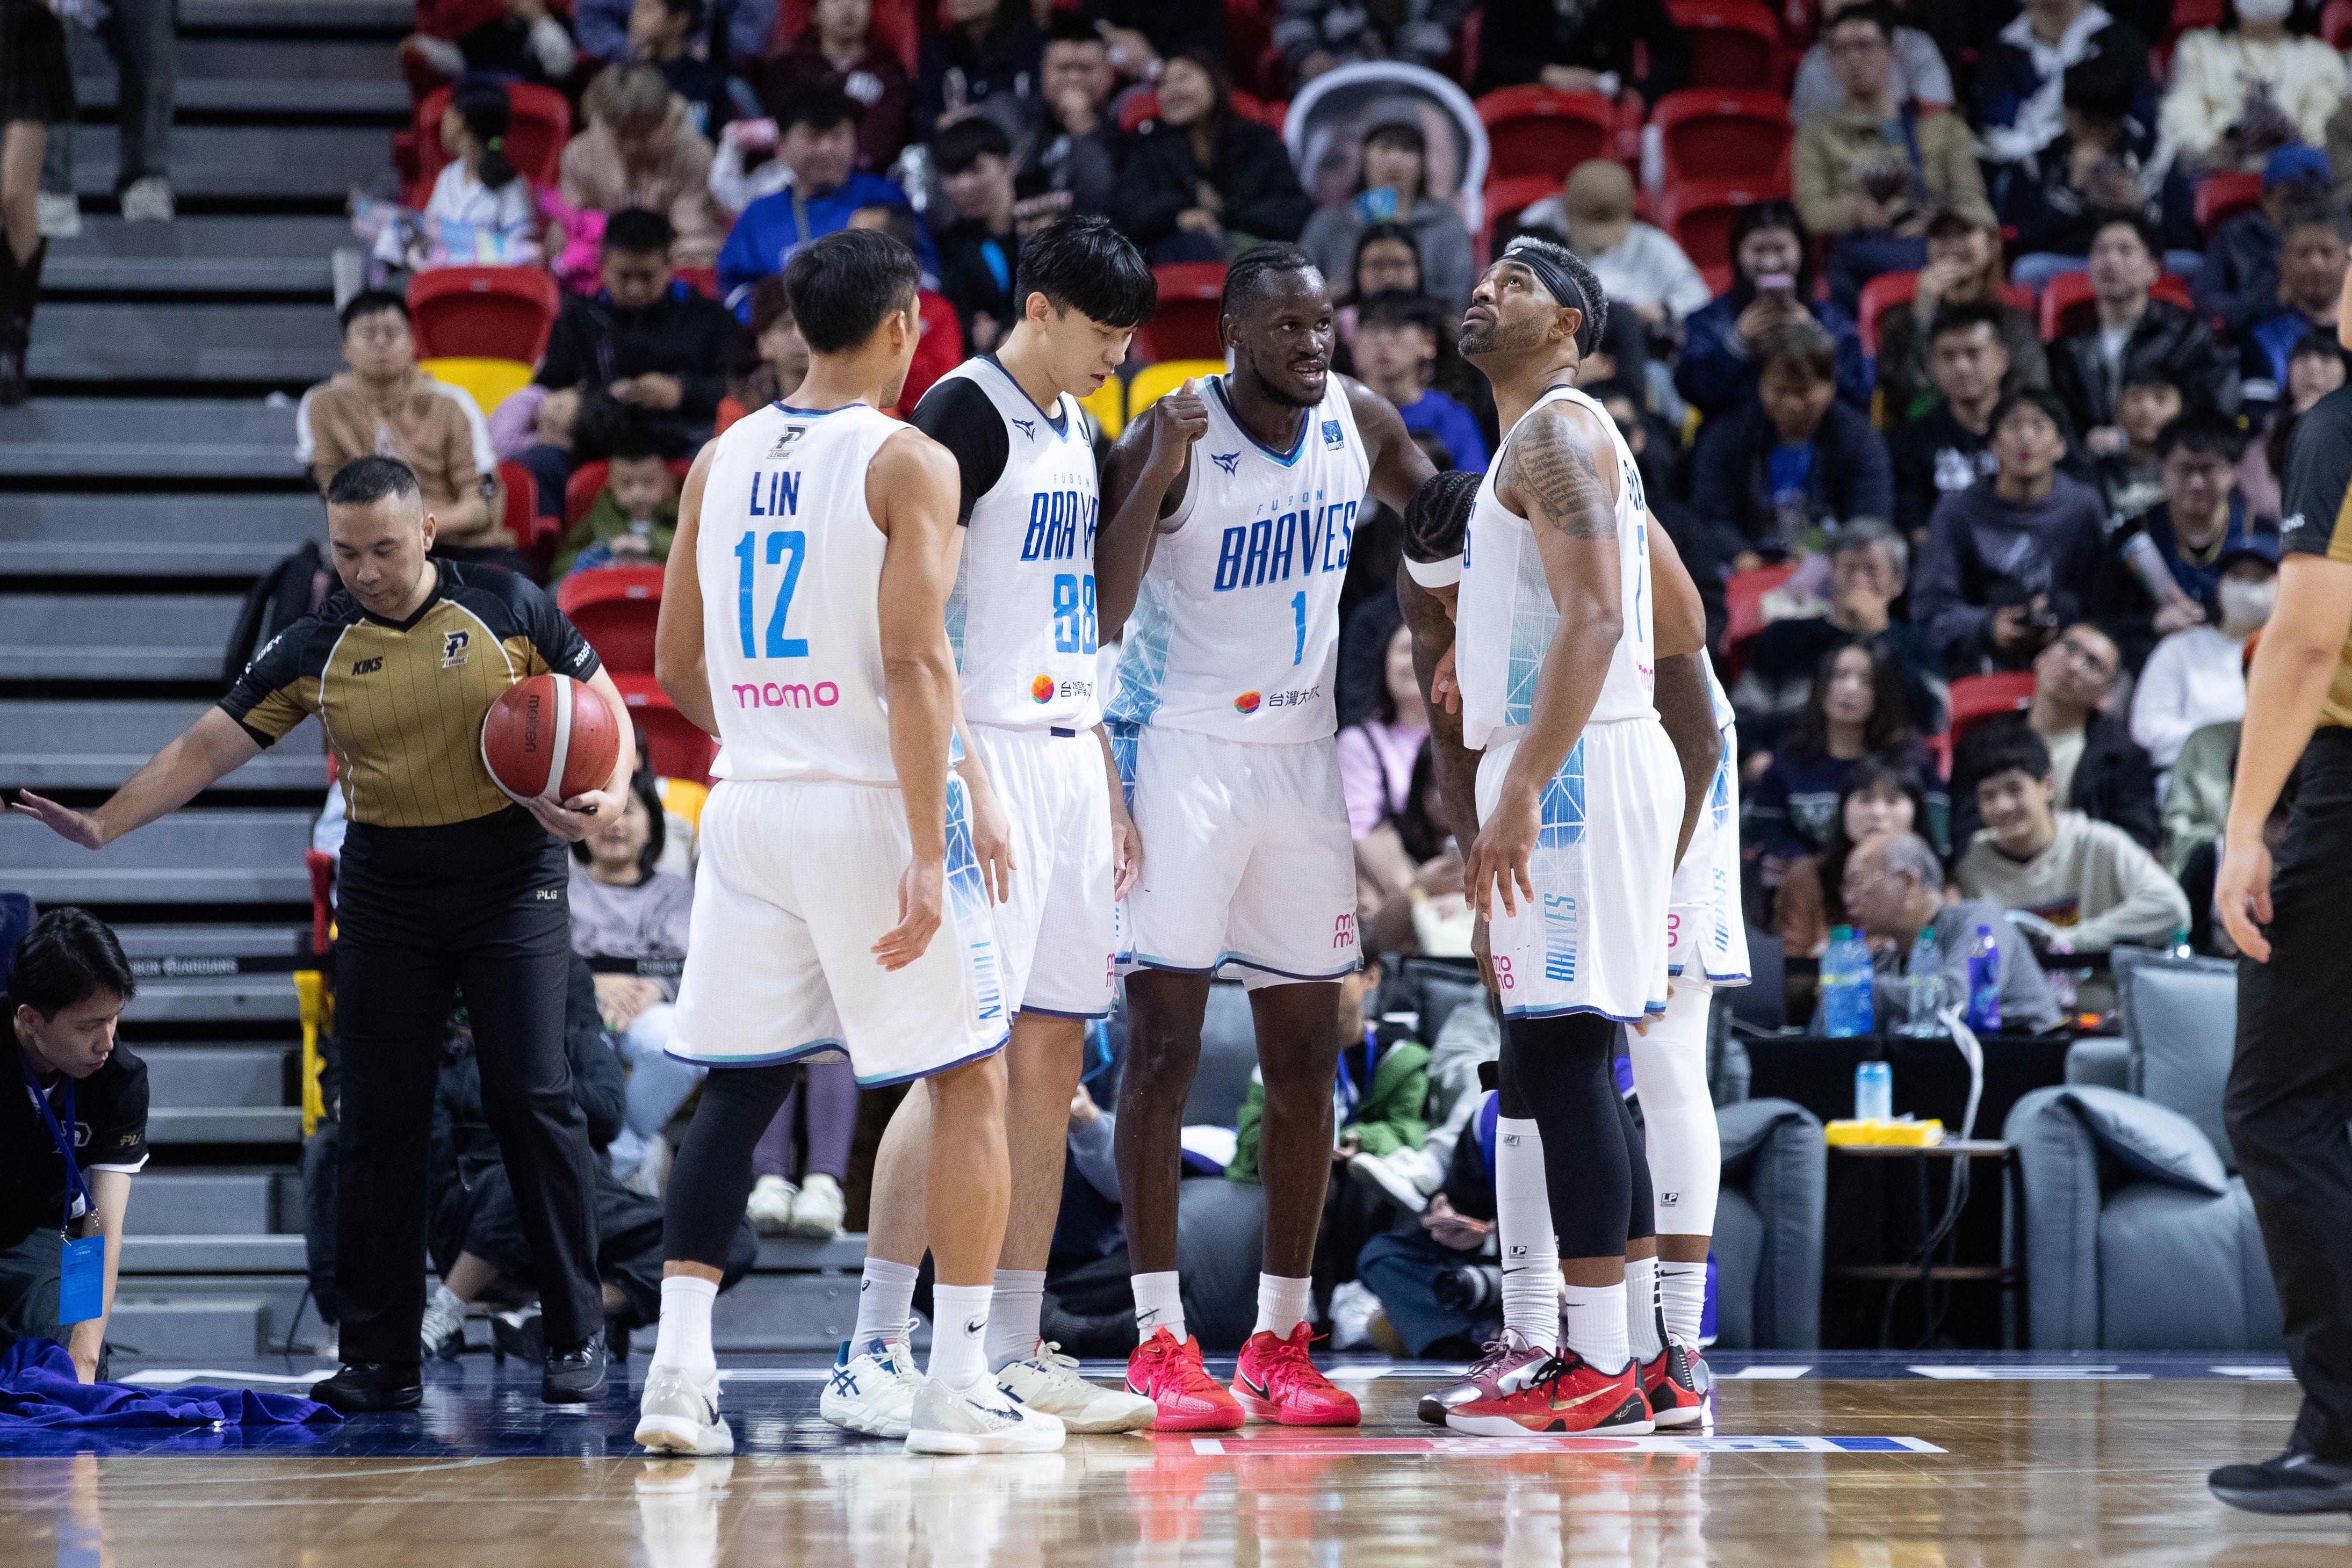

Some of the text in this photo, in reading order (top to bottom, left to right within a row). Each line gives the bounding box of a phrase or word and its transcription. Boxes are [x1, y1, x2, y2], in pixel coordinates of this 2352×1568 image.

[749, 471, 801, 516] LIN
[1054, 473, 1090, 488] FUBON
[1257, 489, 1324, 515] FUBON
[1213, 500, 1357, 592] BRAVES
[734, 530, 809, 659] 12
[1053, 574, 1097, 655] 88
[1290, 590, 1307, 667] 1
[352, 656, 383, 675] KIKS
[731, 681, 839, 709] momo
[536, 889, 558, 900] PLG
[1543, 893, 1578, 982] BRAVES
[1662, 1193, 1677, 1202] LP
[1510, 1246, 1526, 1255] LP
